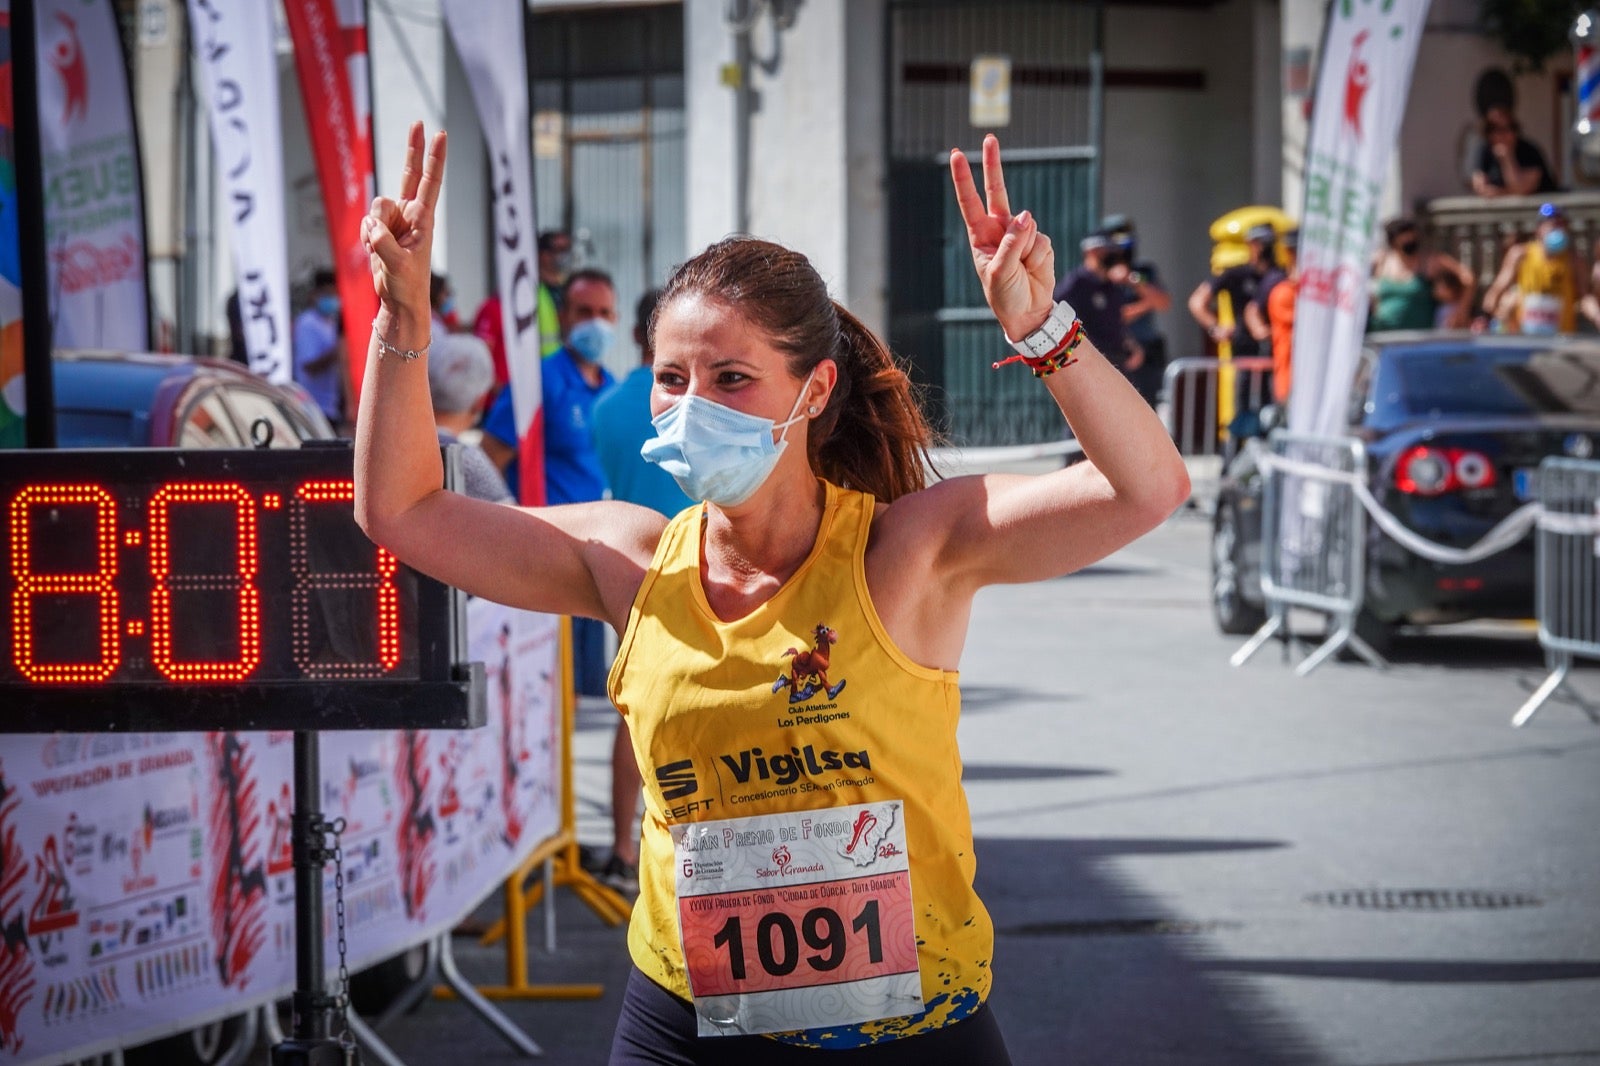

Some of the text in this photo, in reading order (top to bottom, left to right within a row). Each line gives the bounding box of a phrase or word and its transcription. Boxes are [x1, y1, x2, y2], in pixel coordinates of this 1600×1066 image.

[788, 703, 837, 715] Club Atletismo
[778, 712, 850, 728] Los Perdigones
[720, 745, 871, 785] Vigilsa
[730, 787, 798, 804] Concesionario
[800, 783, 822, 793] SEA
[823, 783, 835, 791] en
[664, 799, 714, 819] SEAT
[722, 828, 775, 849] PREMIO
[780, 826, 798, 842] DE
[801, 819, 852, 840] FONDO
[756, 863, 825, 878] Sabor Granada
[713, 899, 884, 981] 1091
